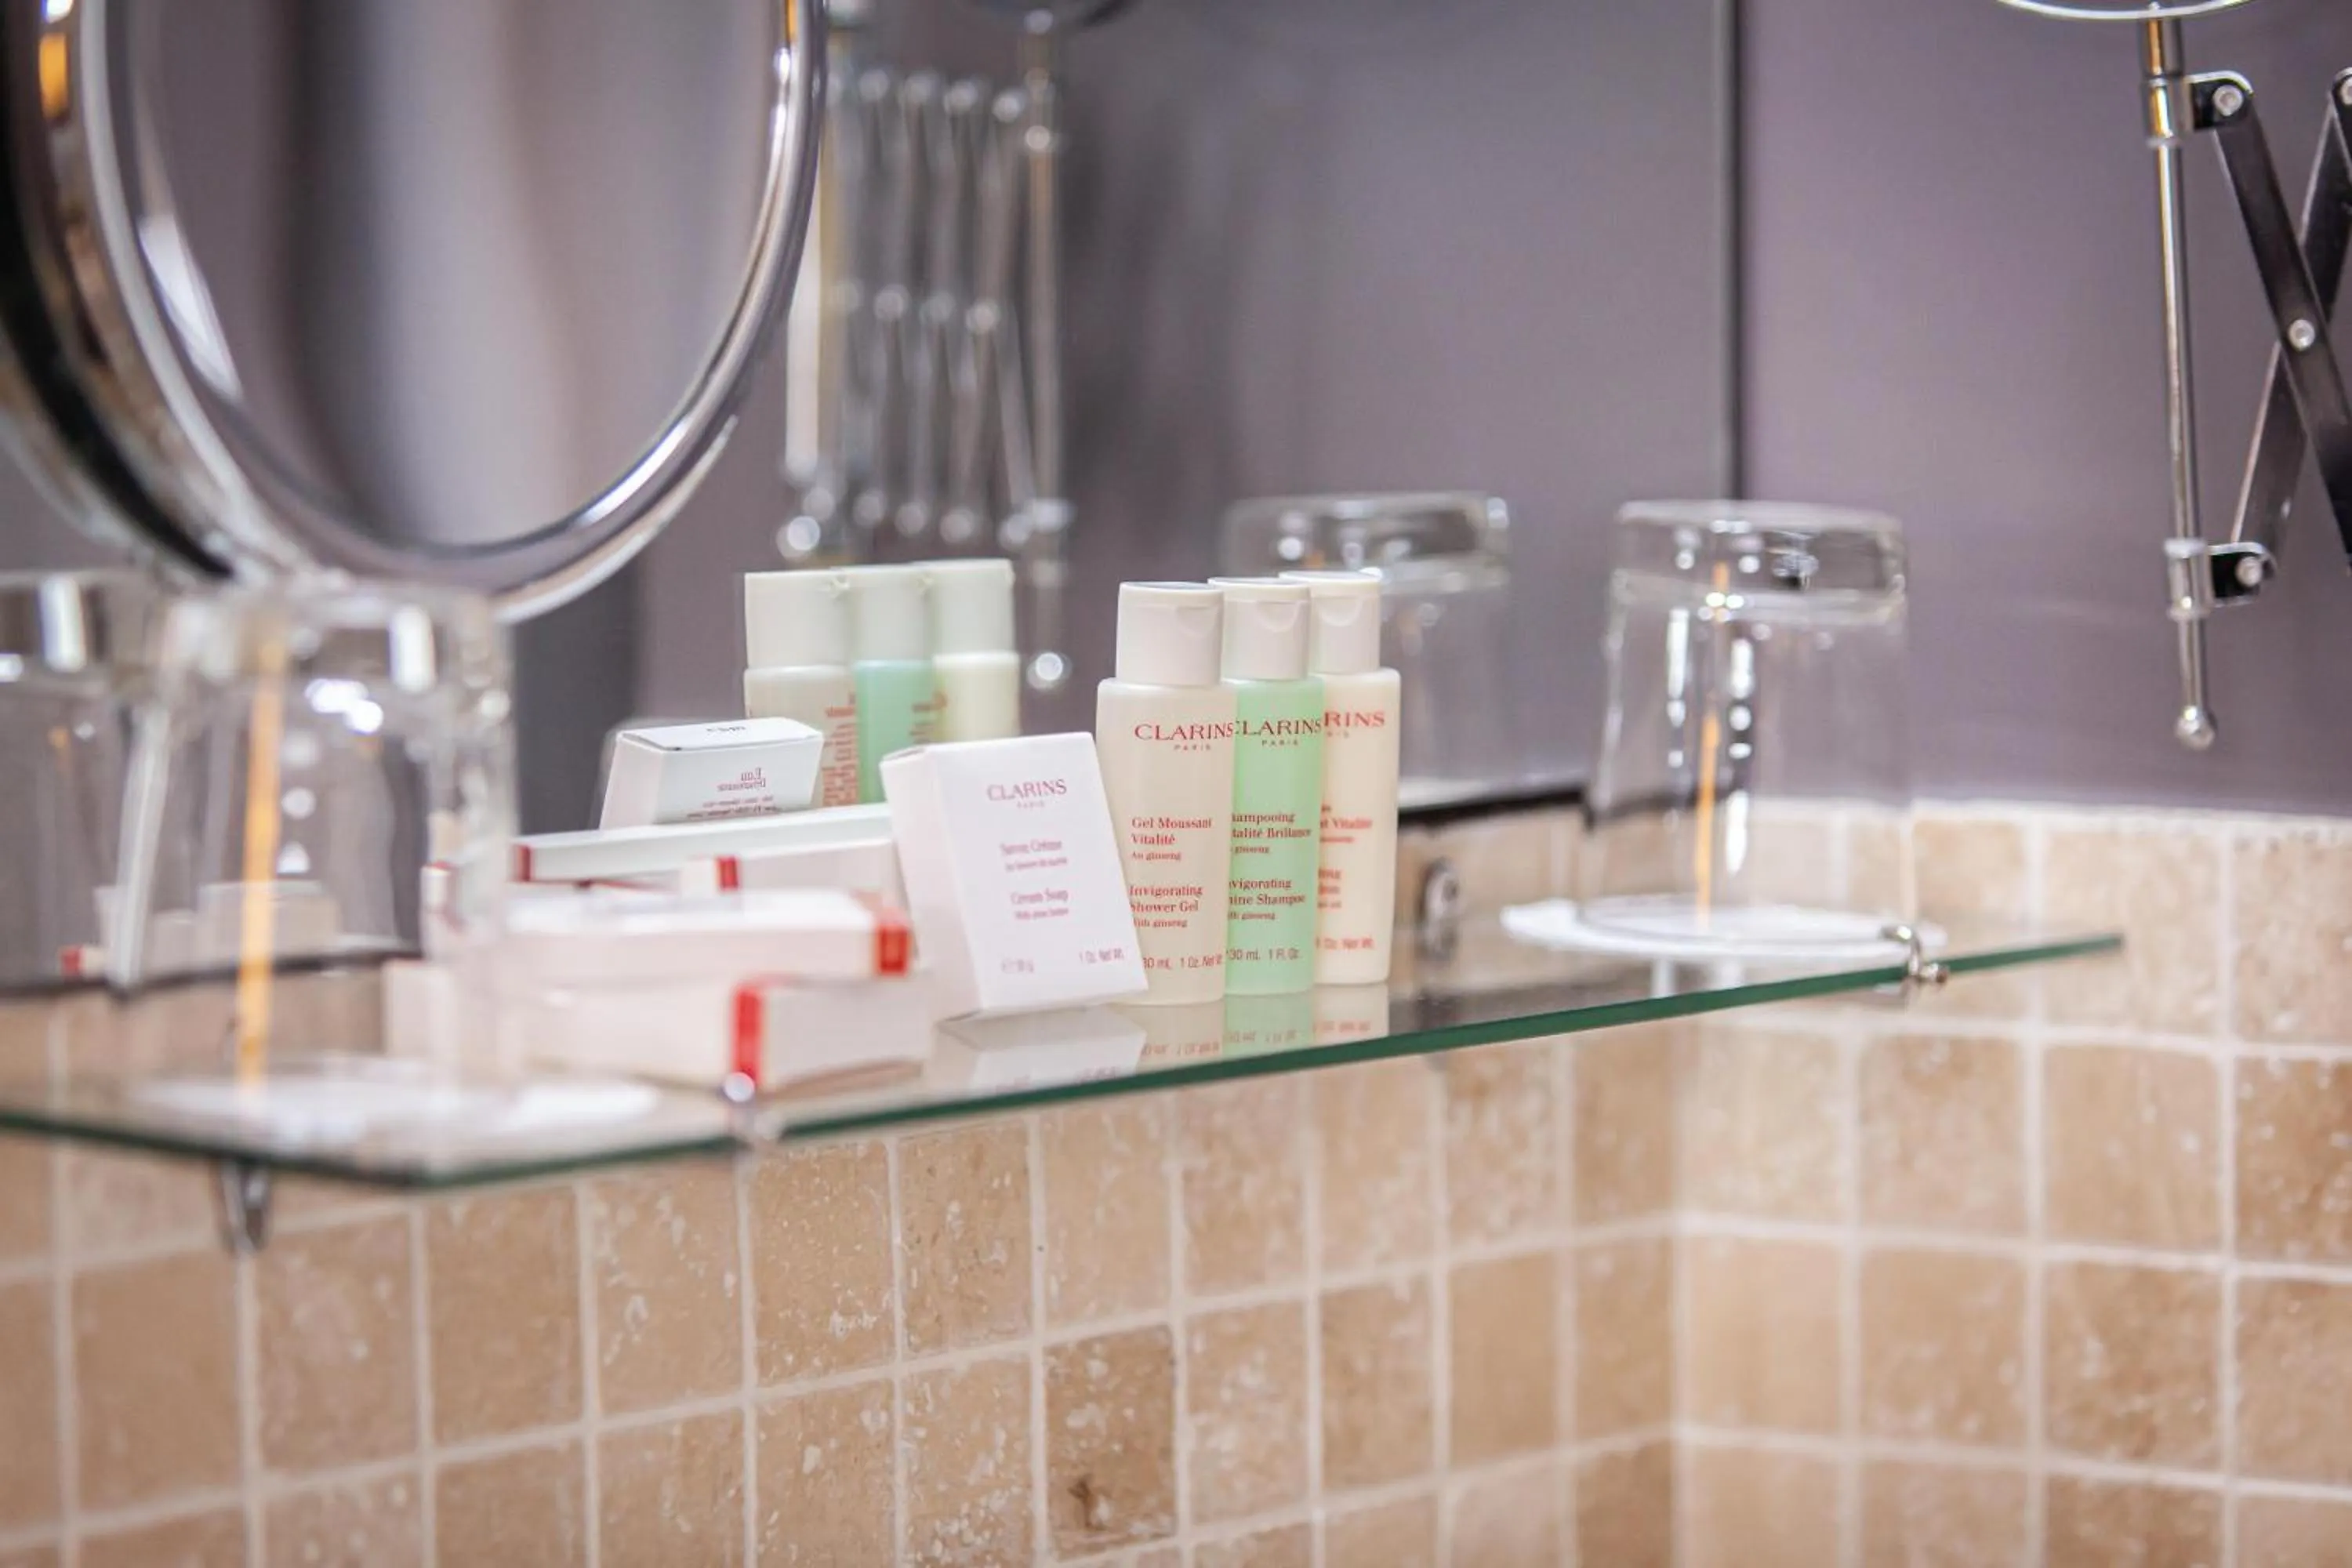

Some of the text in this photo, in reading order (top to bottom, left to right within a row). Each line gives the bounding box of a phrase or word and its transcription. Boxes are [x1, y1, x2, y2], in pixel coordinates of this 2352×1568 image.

[1324, 711, 1385, 728] RINS
[1134, 722, 1234, 741] CLARINS
[986, 779, 1067, 801] CLARINS
[1131, 817, 1213, 829] Gel Moussant
[1131, 833, 1176, 846] Vitalité
[1129, 884, 1203, 898] Invigorating
[1180, 899, 1199, 912] Gel
